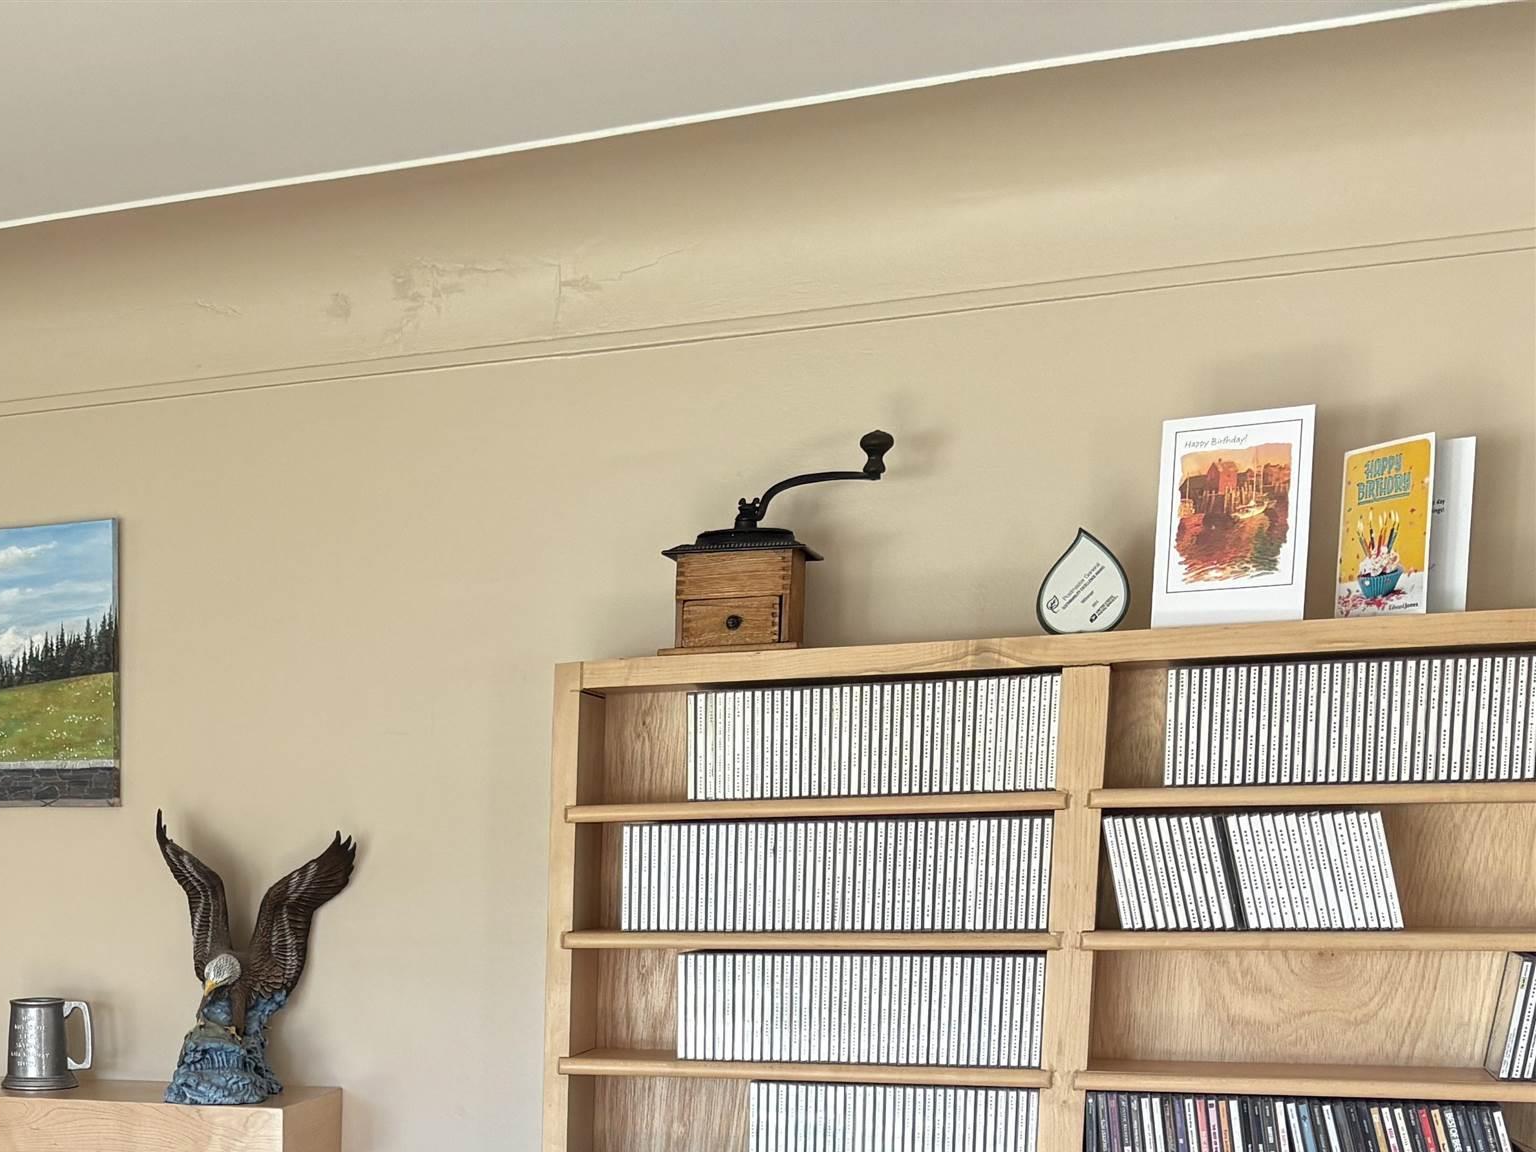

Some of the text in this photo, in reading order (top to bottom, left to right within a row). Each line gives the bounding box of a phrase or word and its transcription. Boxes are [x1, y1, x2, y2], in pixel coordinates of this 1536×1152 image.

[1184, 434, 1248, 449] Happy Birthday!
[1364, 453, 1403, 479] HAPPY
[1357, 471, 1411, 501] BIRTHDAY
[1445, 1113, 1456, 1128] BEST
